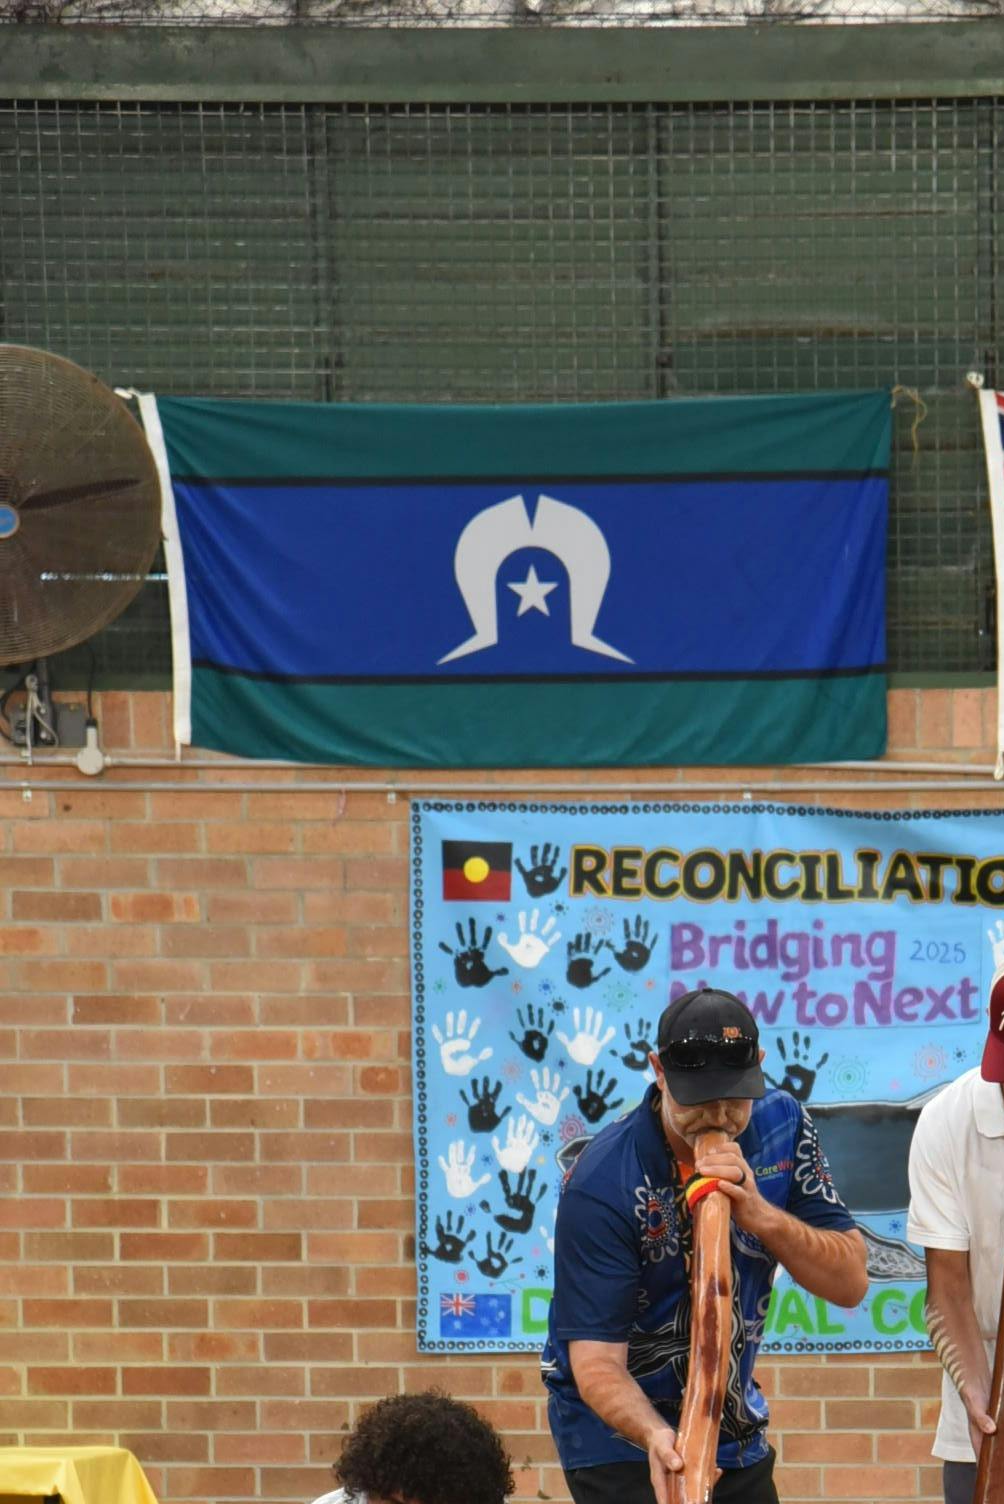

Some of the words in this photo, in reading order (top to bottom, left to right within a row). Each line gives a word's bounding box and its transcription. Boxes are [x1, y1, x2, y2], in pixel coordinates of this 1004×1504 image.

[670, 919, 896, 981] Bridging
[909, 939, 967, 964] 2025
[853, 977, 979, 1026] Next
